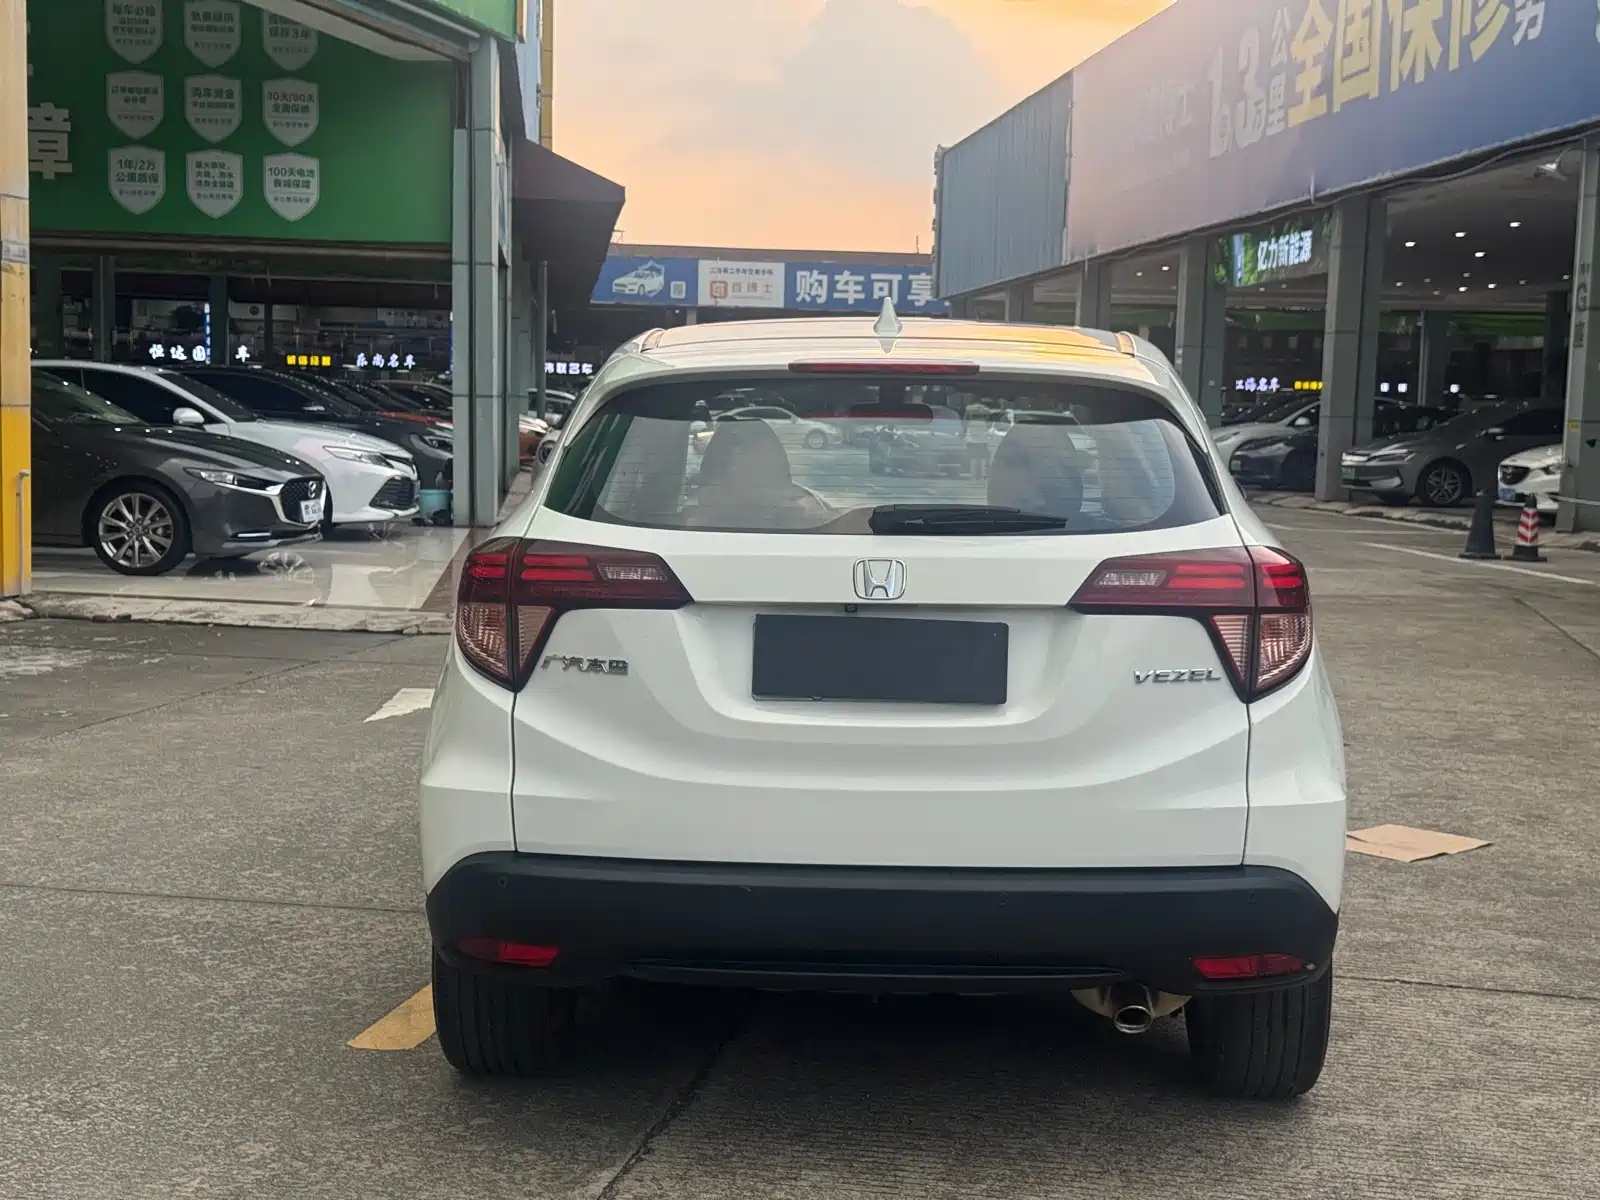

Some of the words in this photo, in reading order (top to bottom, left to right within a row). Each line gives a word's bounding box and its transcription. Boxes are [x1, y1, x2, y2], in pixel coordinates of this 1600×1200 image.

[28, 102, 73, 180] 章
[795, 268, 933, 307] 购车可享
[540, 653, 629, 676] 广汽本田
[1132, 667, 1222, 684] VEZEL
